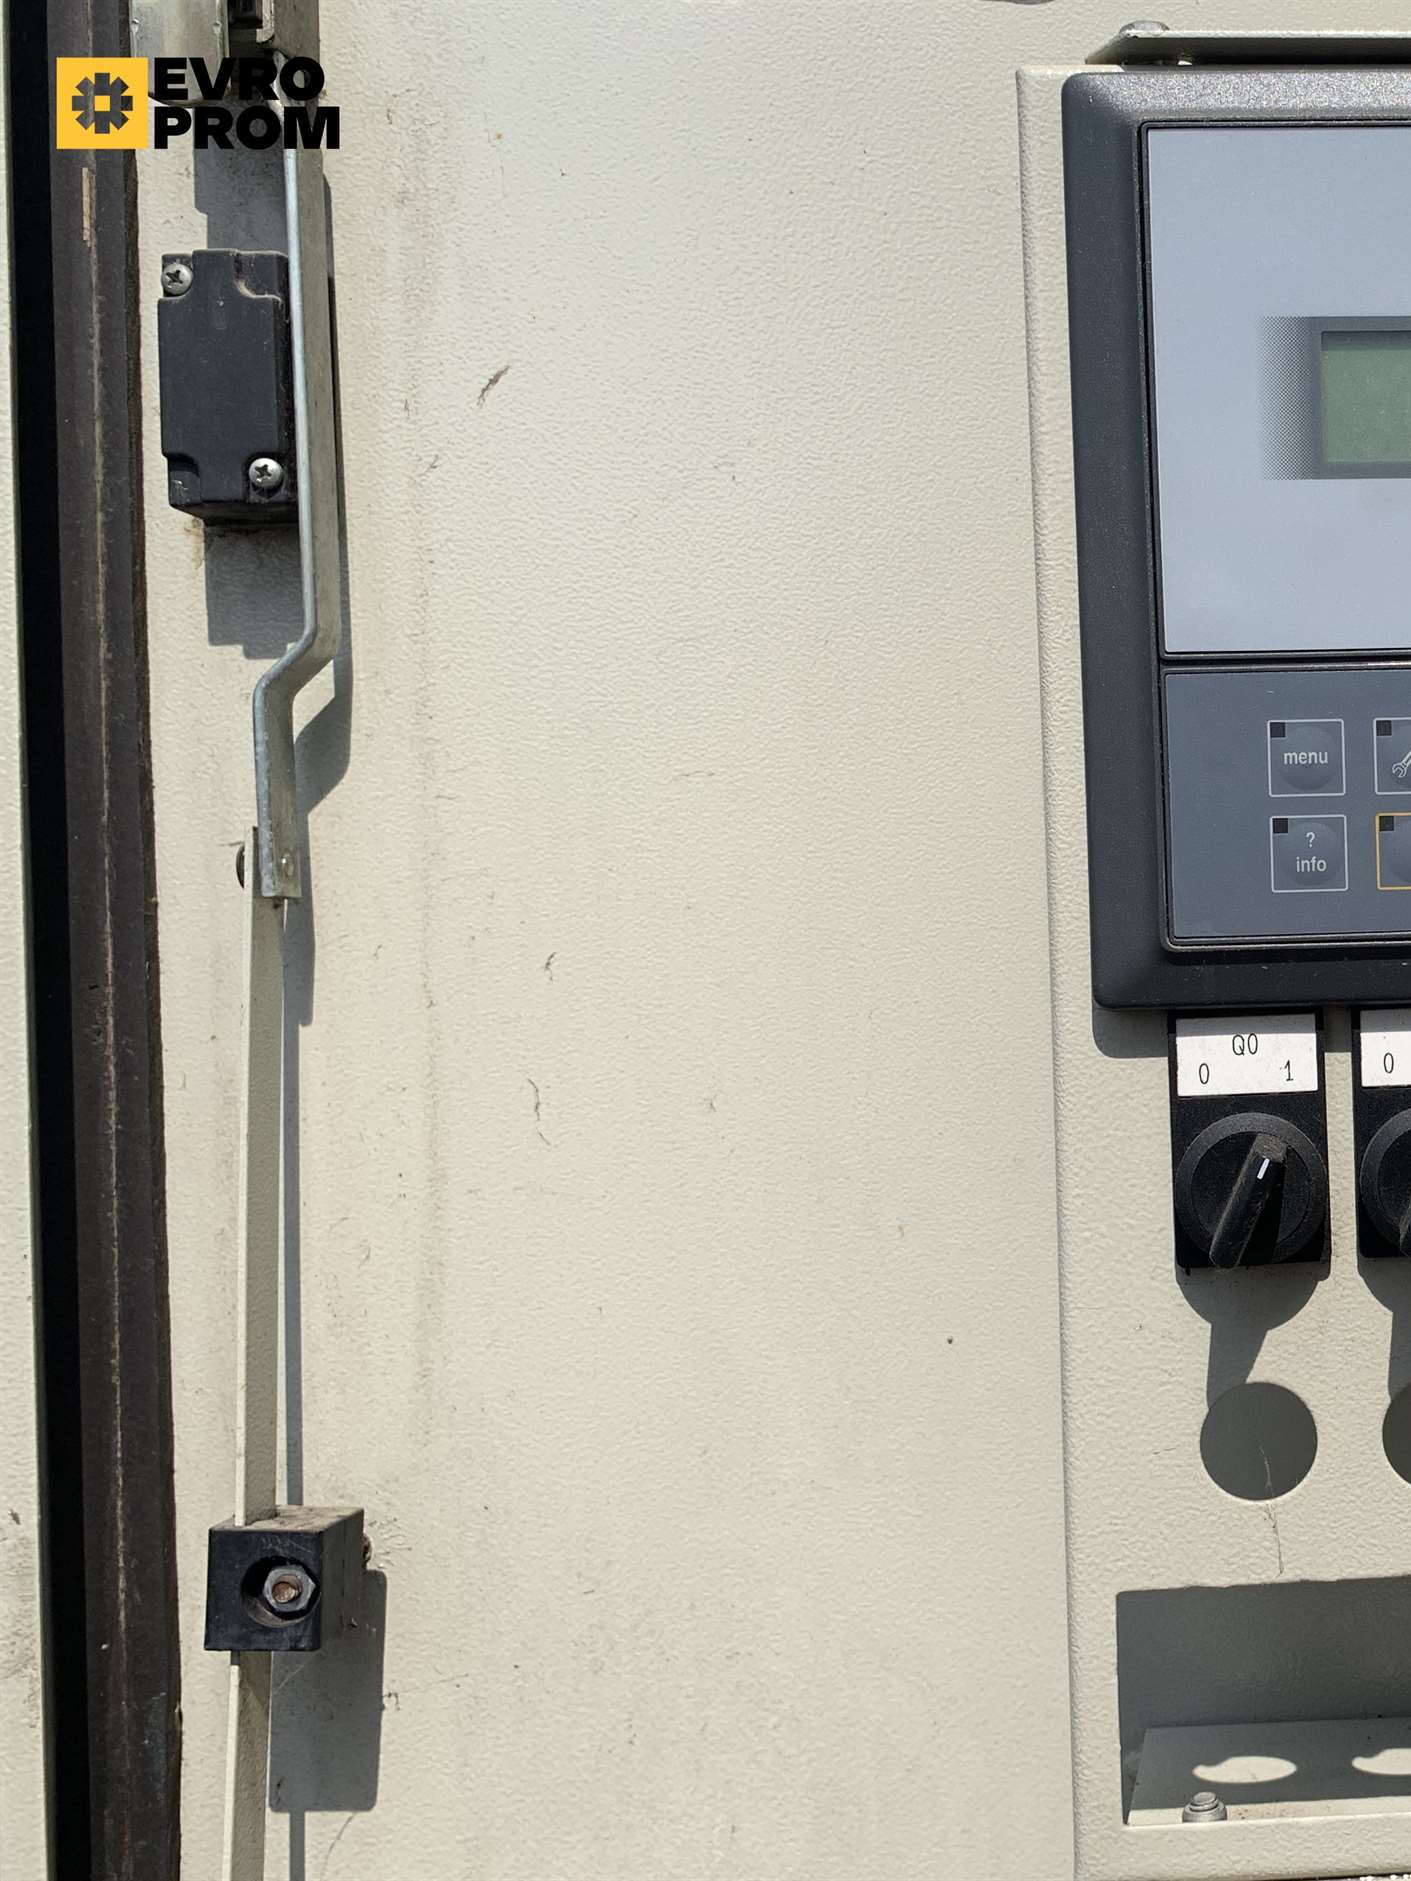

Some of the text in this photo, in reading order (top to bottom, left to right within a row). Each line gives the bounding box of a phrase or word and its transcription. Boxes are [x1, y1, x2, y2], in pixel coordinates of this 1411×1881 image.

[1283, 751, 1329, 766] menu
[1296, 856, 1327, 873] info
[1232, 1033, 1259, 1056] Q0
[1284, 1059, 1294, 1082] 1
